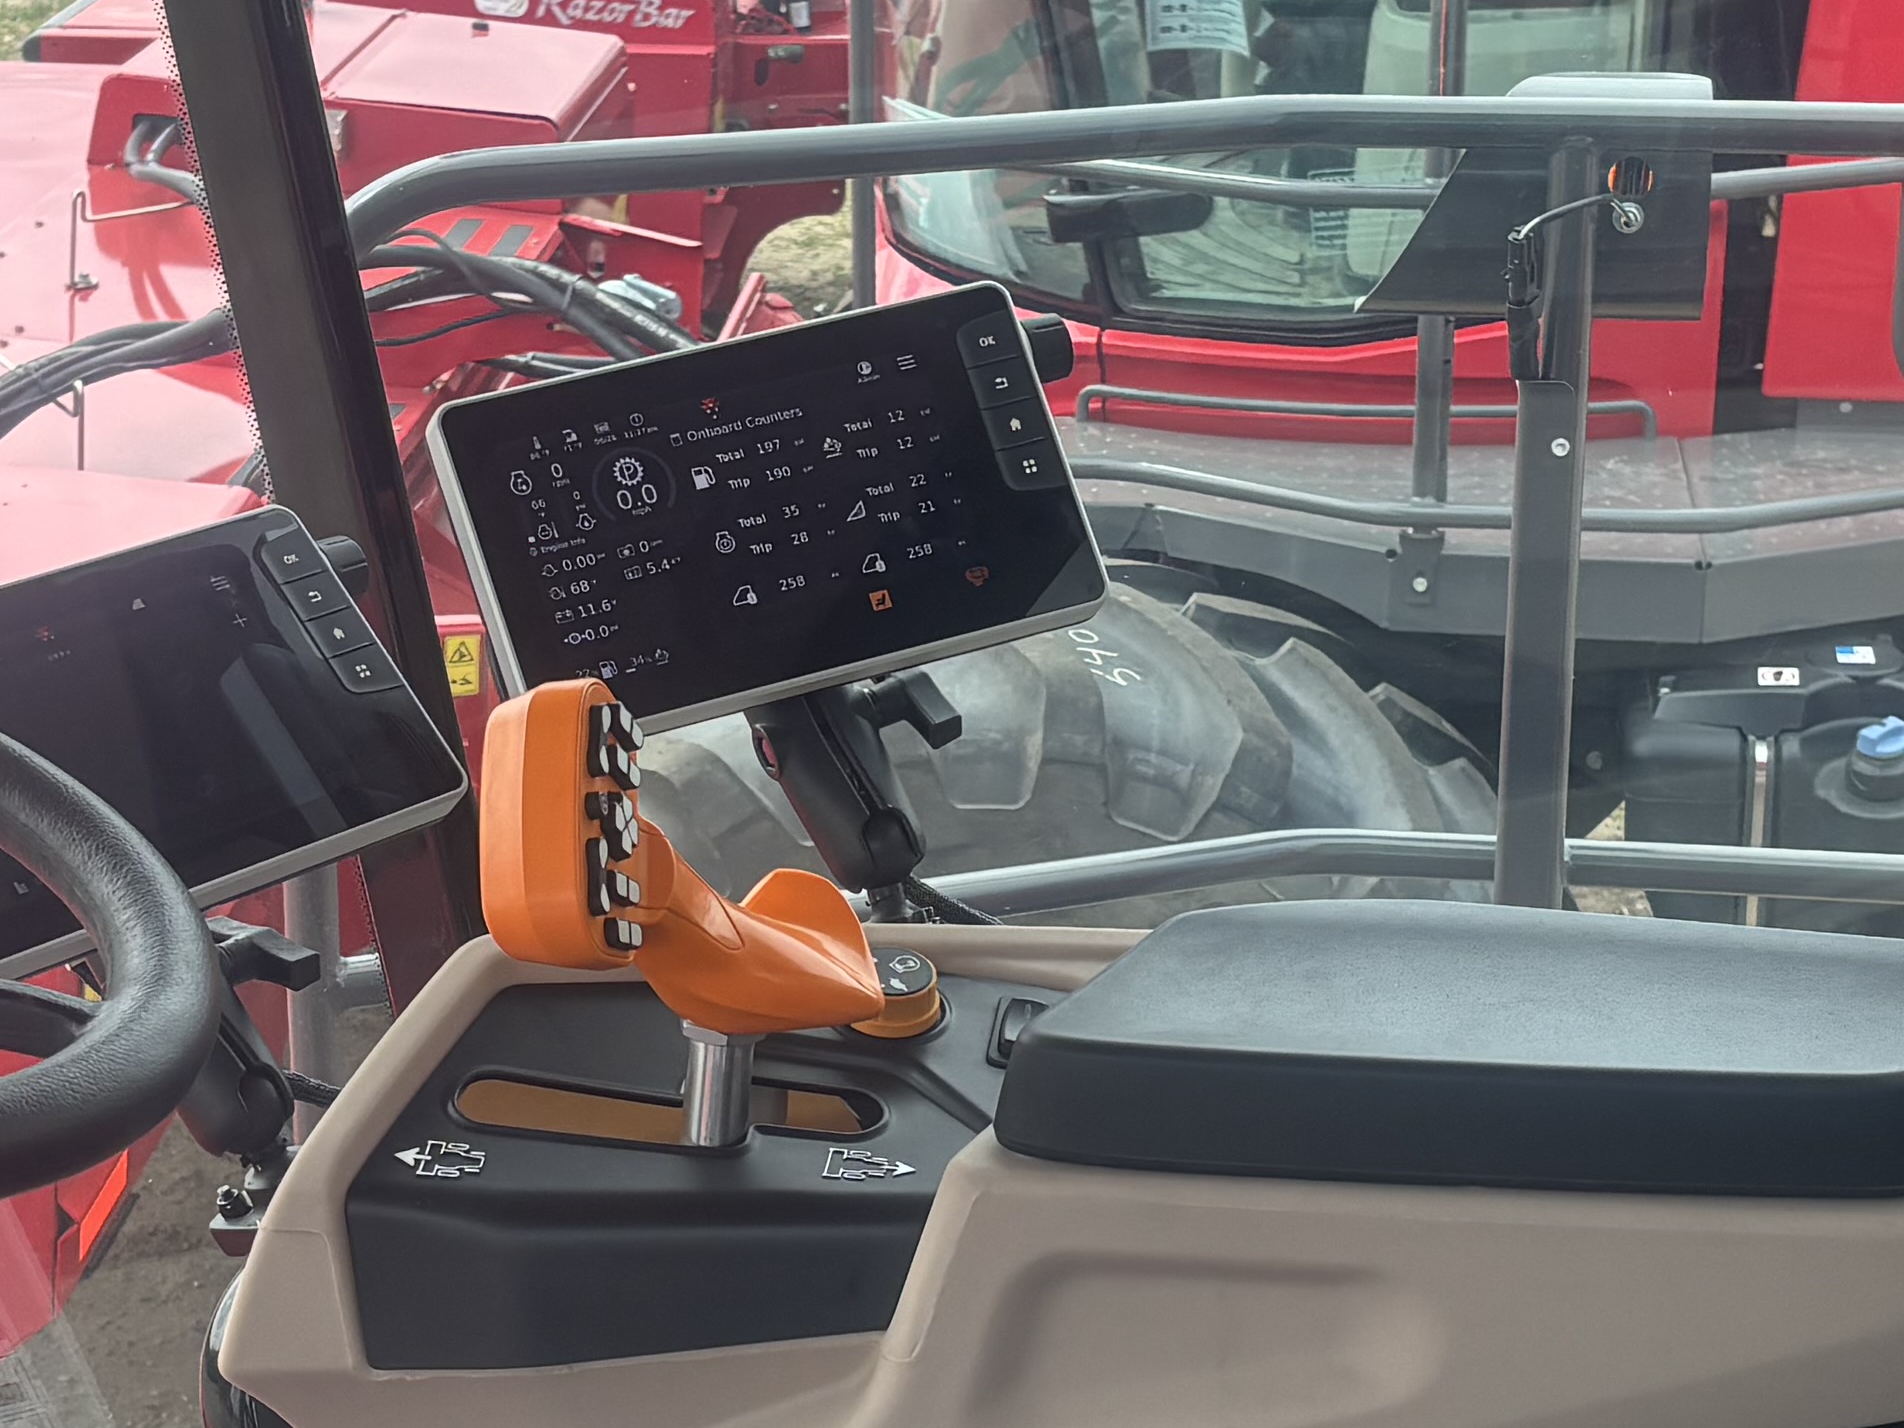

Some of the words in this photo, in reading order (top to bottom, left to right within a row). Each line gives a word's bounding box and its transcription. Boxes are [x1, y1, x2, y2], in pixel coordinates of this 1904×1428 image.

[979, 336, 996, 347] OK
[687, 421, 742, 441] Onboard
[746, 407, 803, 428] Counters
[843, 418, 872, 433] Total
[888, 410, 905, 422] 12
[715, 449, 745, 463] Total
[757, 439, 781, 454] 197
[856, 447, 878, 459] Trip
[897, 436, 914, 449] 12
[550, 463, 563, 478] 0
[728, 478, 750, 490] Trip
[766, 466, 791, 482] 190
[865, 483, 894, 496] Total
[909, 474, 927, 487] 22
[617, 484, 658, 510] 0.0
[737, 513, 767, 528] Total
[782, 505, 800, 519] 35
[878, 511, 901, 523] Trip
[918, 501, 936, 513] 21
[639, 540, 649, 553] 0
[749, 543, 773, 555] Trip
[791, 531, 809, 545] 28
[907, 543, 933, 559] 258
[562, 553, 596, 571] 0.00
[646, 559, 671, 575] 5.4
[570, 579, 590, 594] 68
[779, 575, 806, 591] 258
[578, 599, 612, 617] 11.6
[585, 625, 610, 641] 0.0
